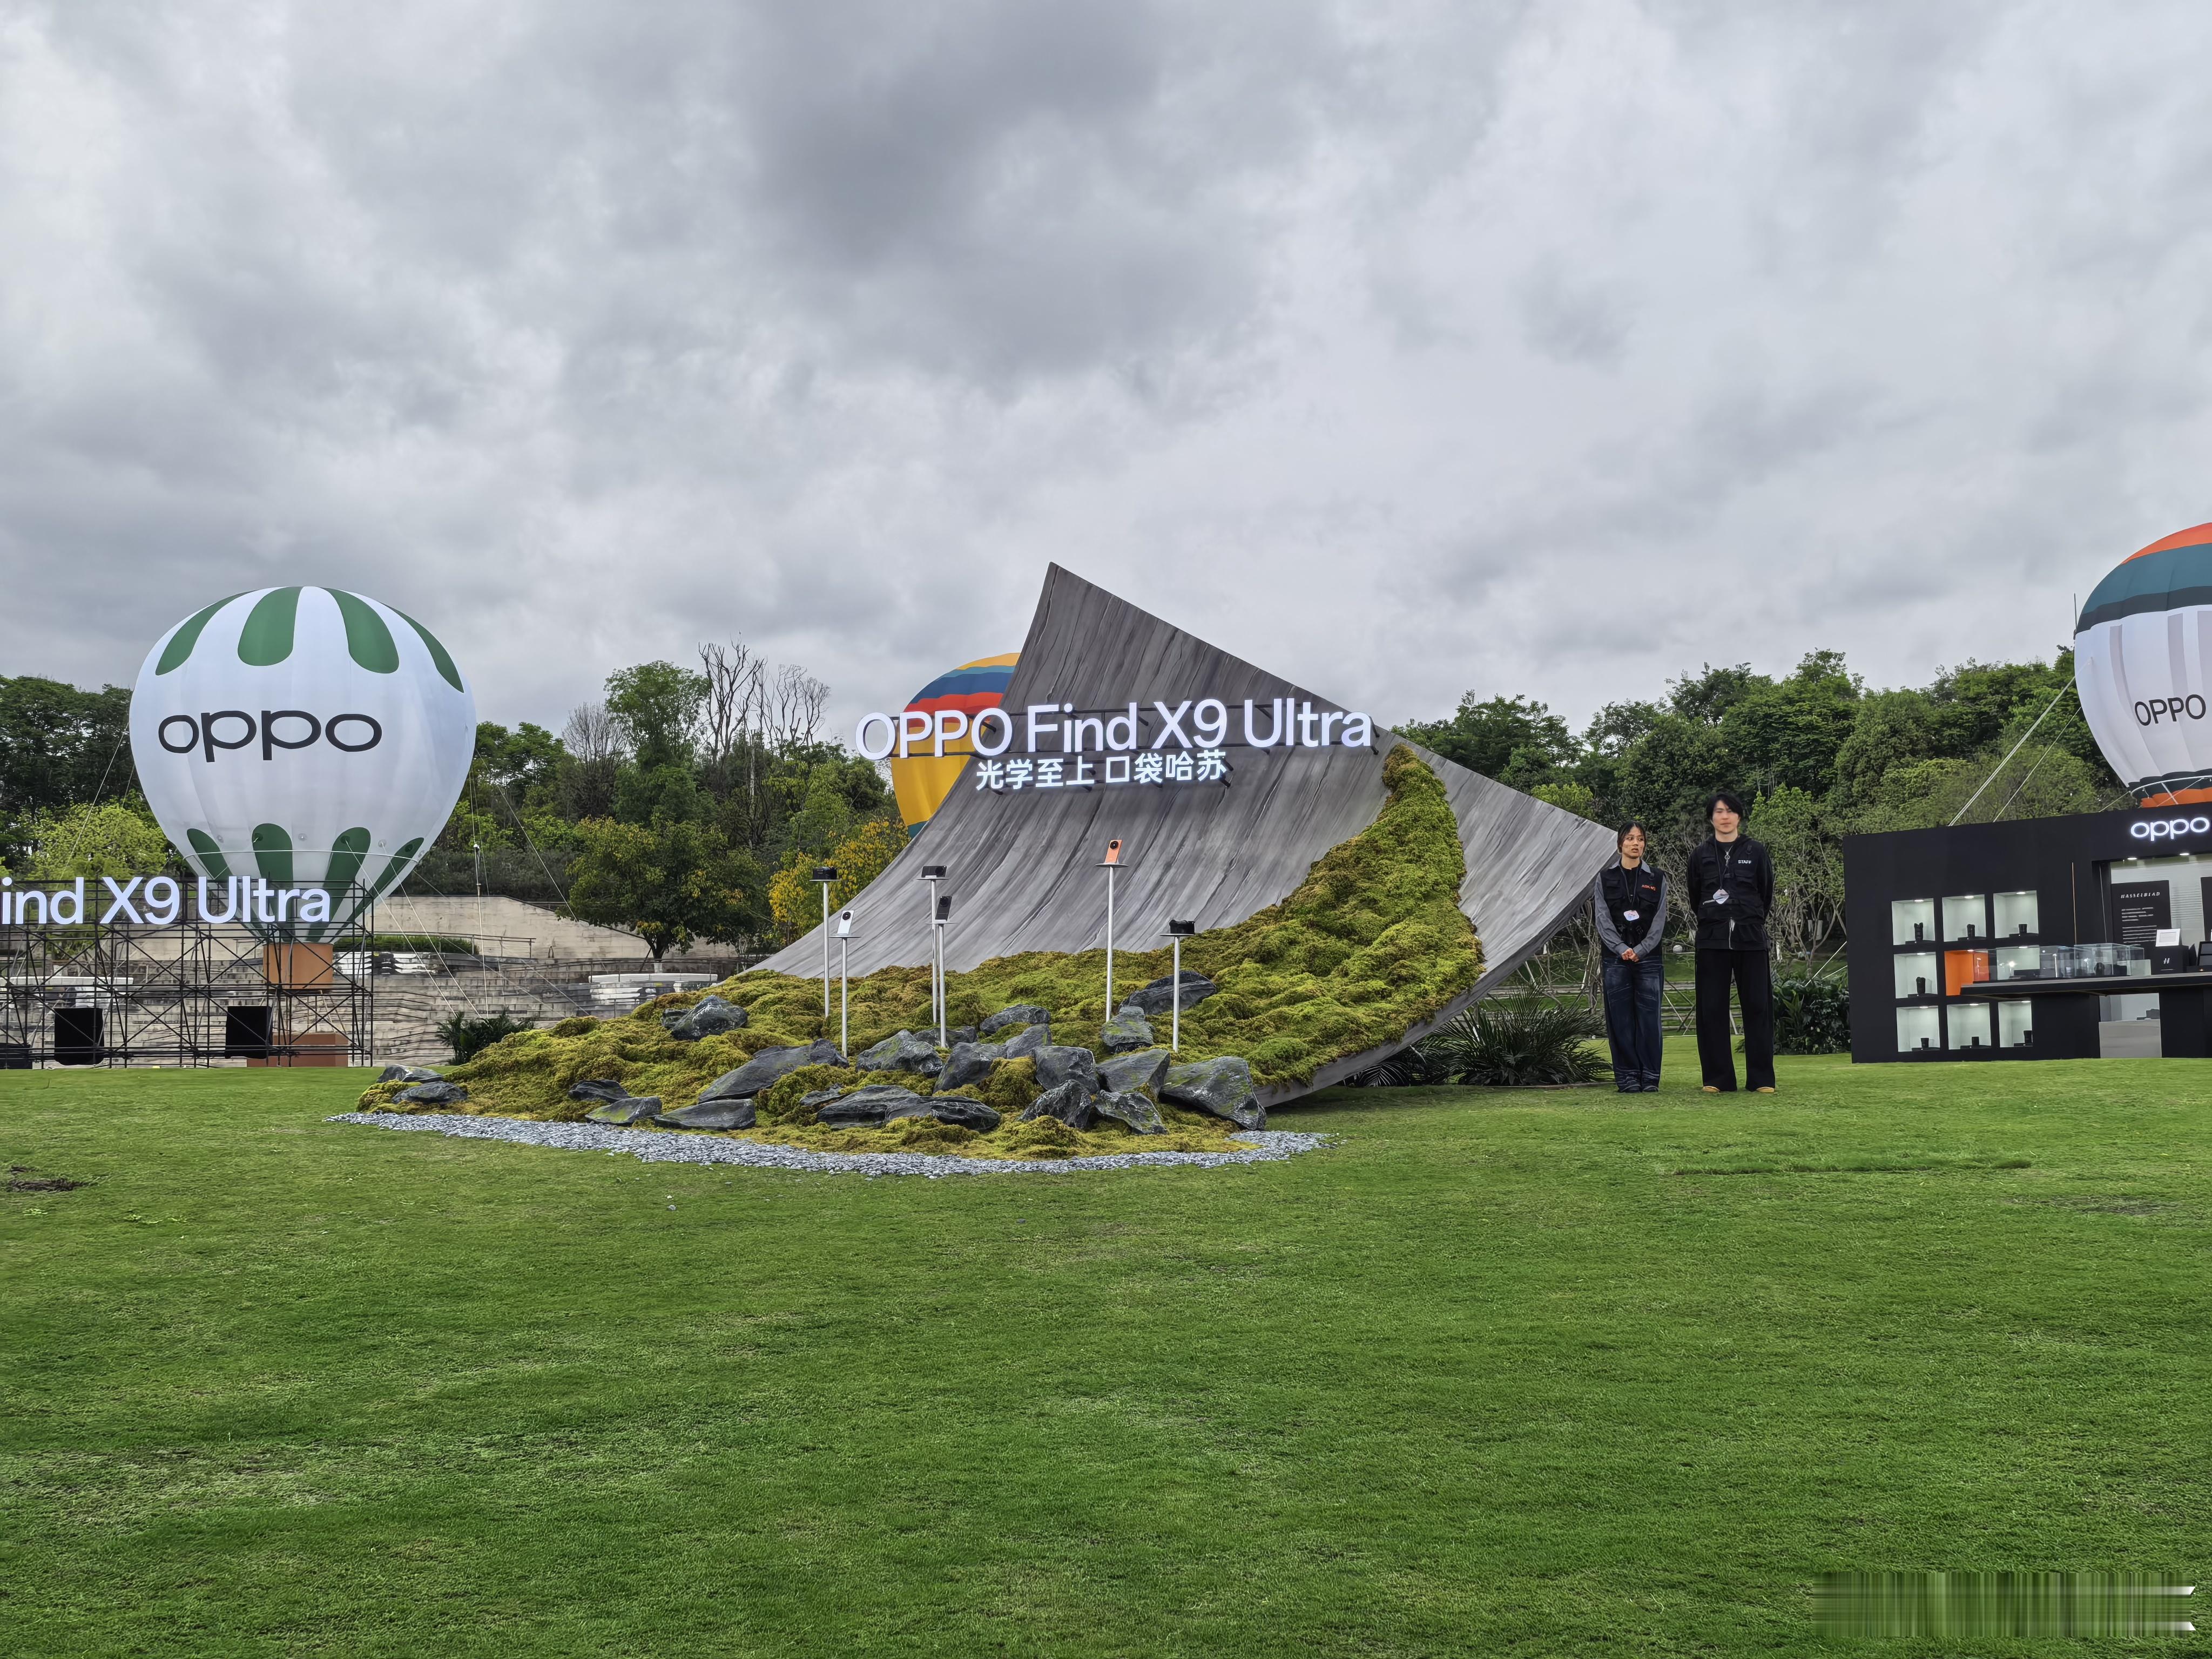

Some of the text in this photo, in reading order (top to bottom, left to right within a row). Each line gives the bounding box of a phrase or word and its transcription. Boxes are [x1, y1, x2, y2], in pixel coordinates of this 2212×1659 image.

[855, 698, 1372, 760] OPPO Find X9 Ultra
[2134, 694, 2207, 726] OPPO
[158, 710, 382, 763] oppo
[976, 749, 1226, 791] 光学至上 口袋哈苏
[2130, 817, 2210, 841] oppo
[99, 876, 180, 925] X9
[198, 875, 331, 924] Ultra
